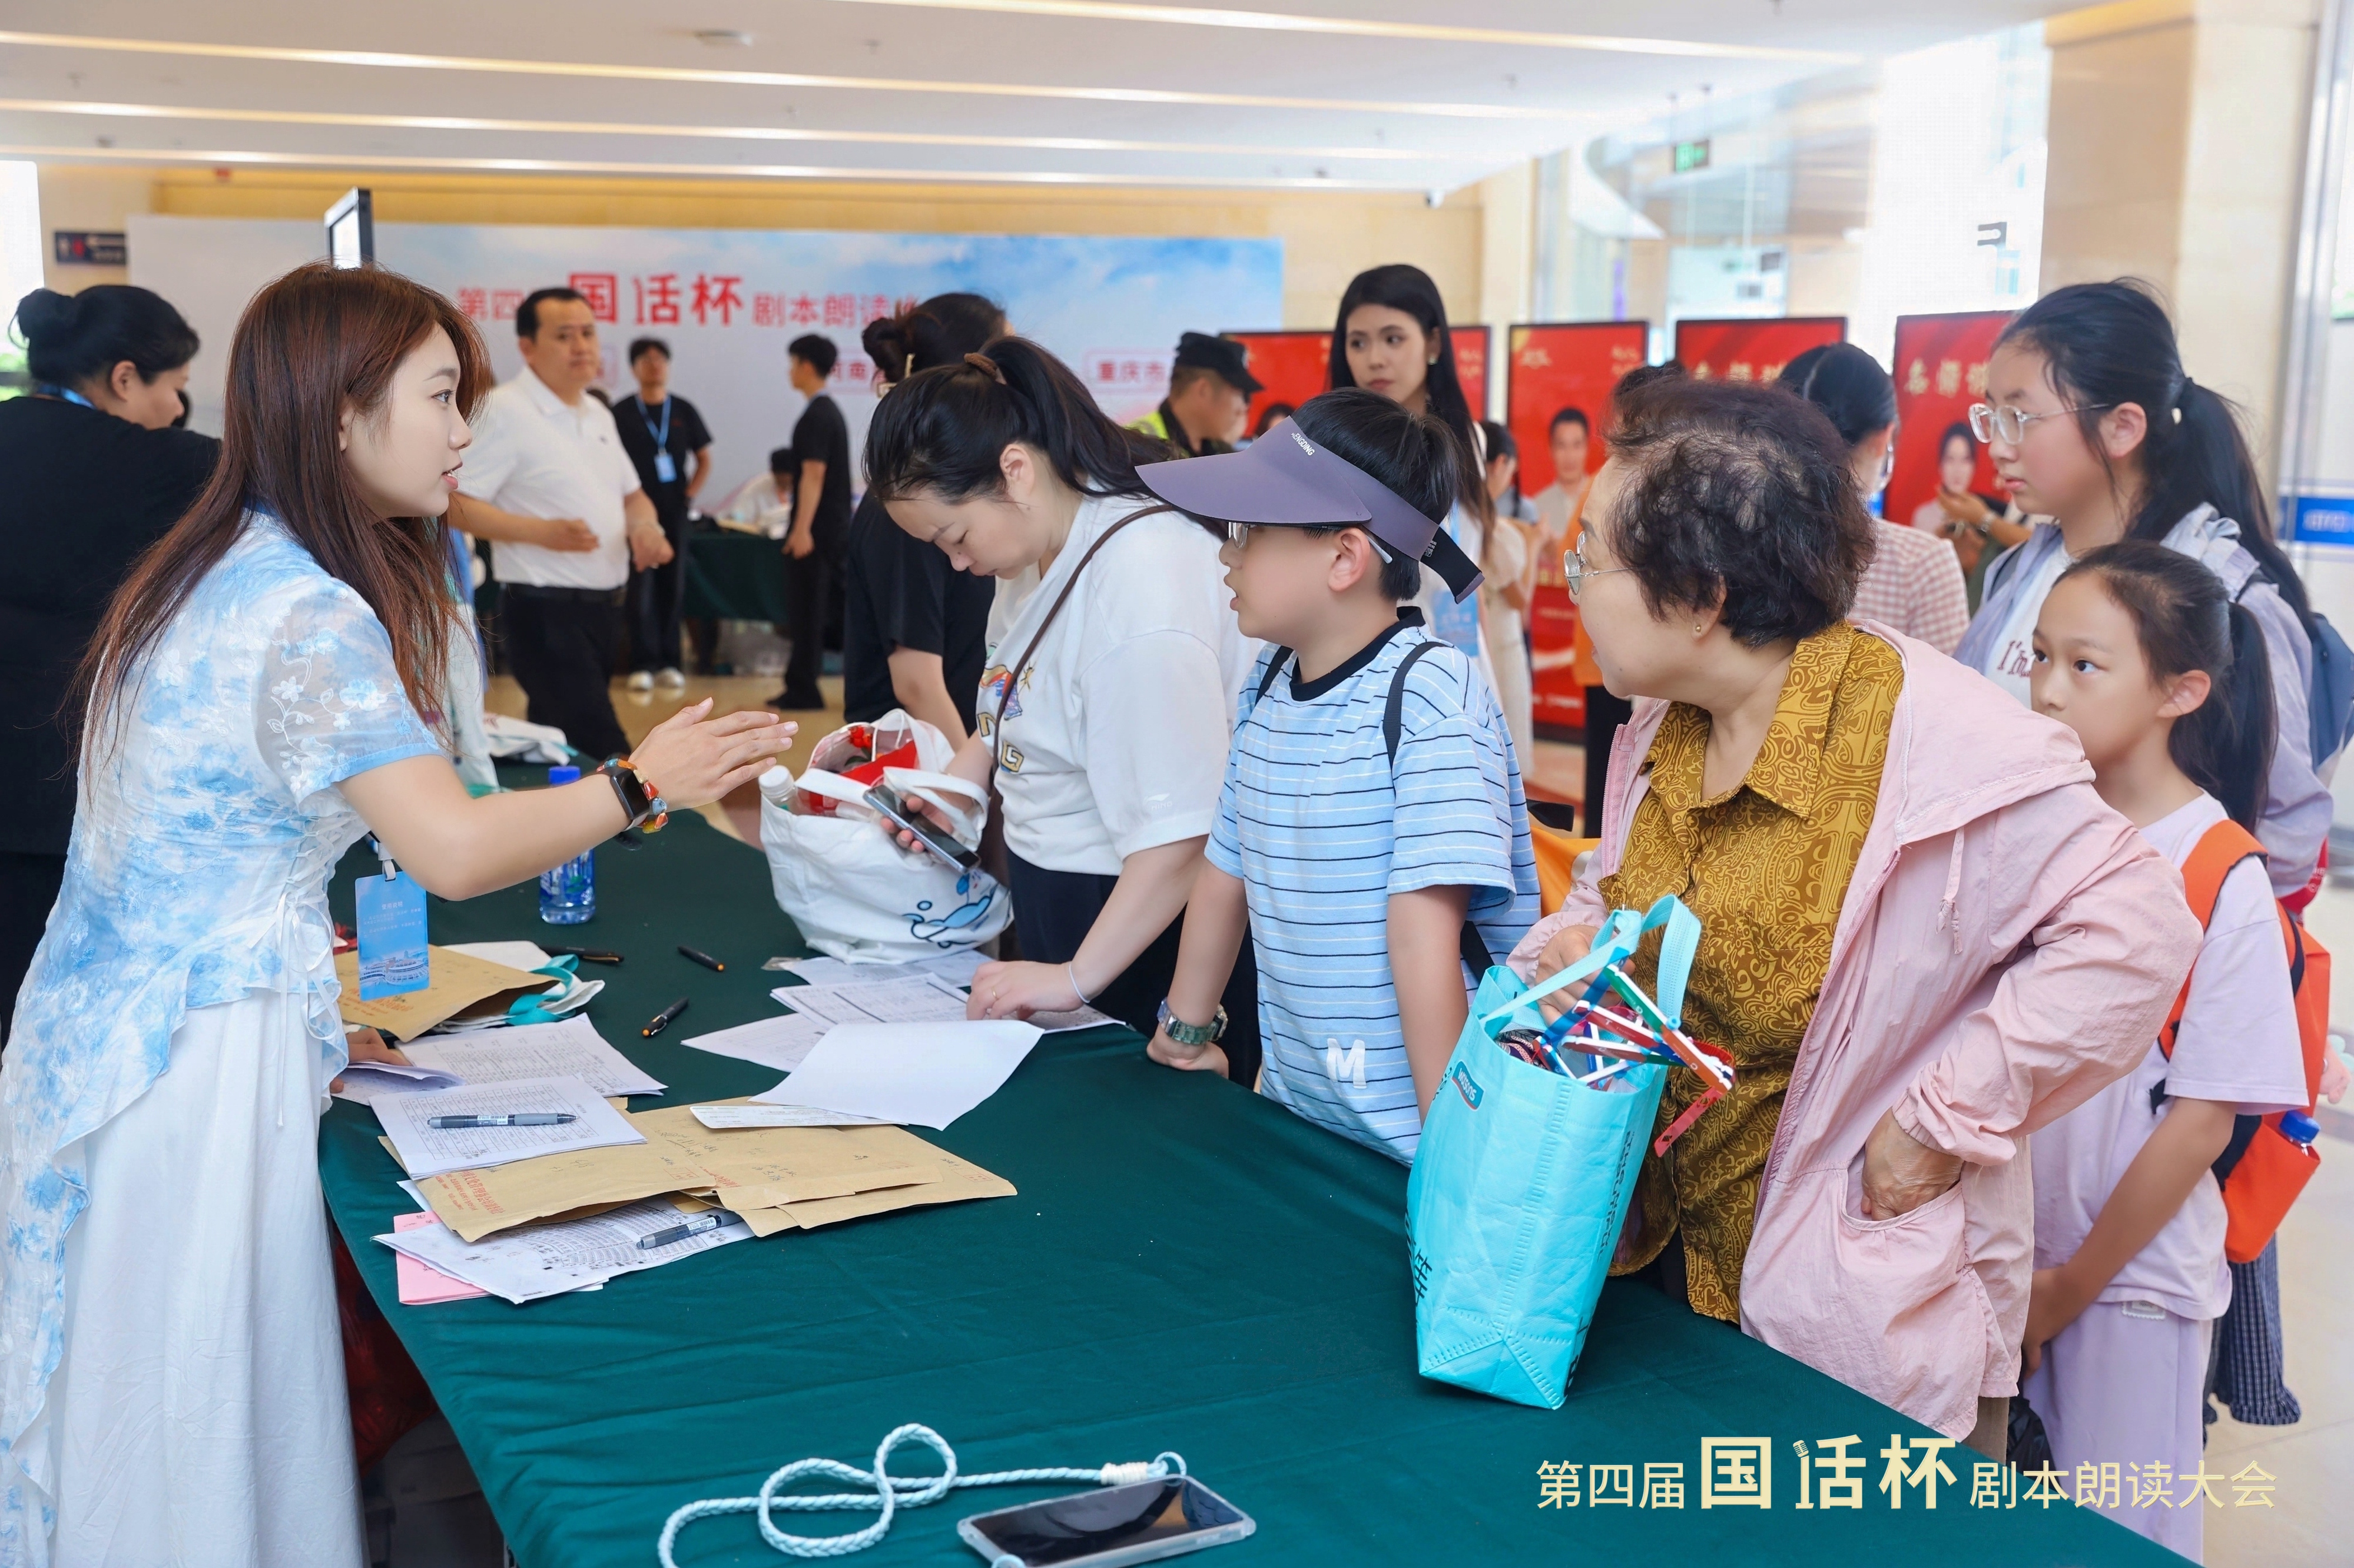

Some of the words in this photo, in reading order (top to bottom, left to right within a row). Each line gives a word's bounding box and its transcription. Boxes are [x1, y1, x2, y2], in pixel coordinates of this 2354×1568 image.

[753, 292, 916, 328] 剧本朗读
[1326, 1038, 1367, 1089] M
